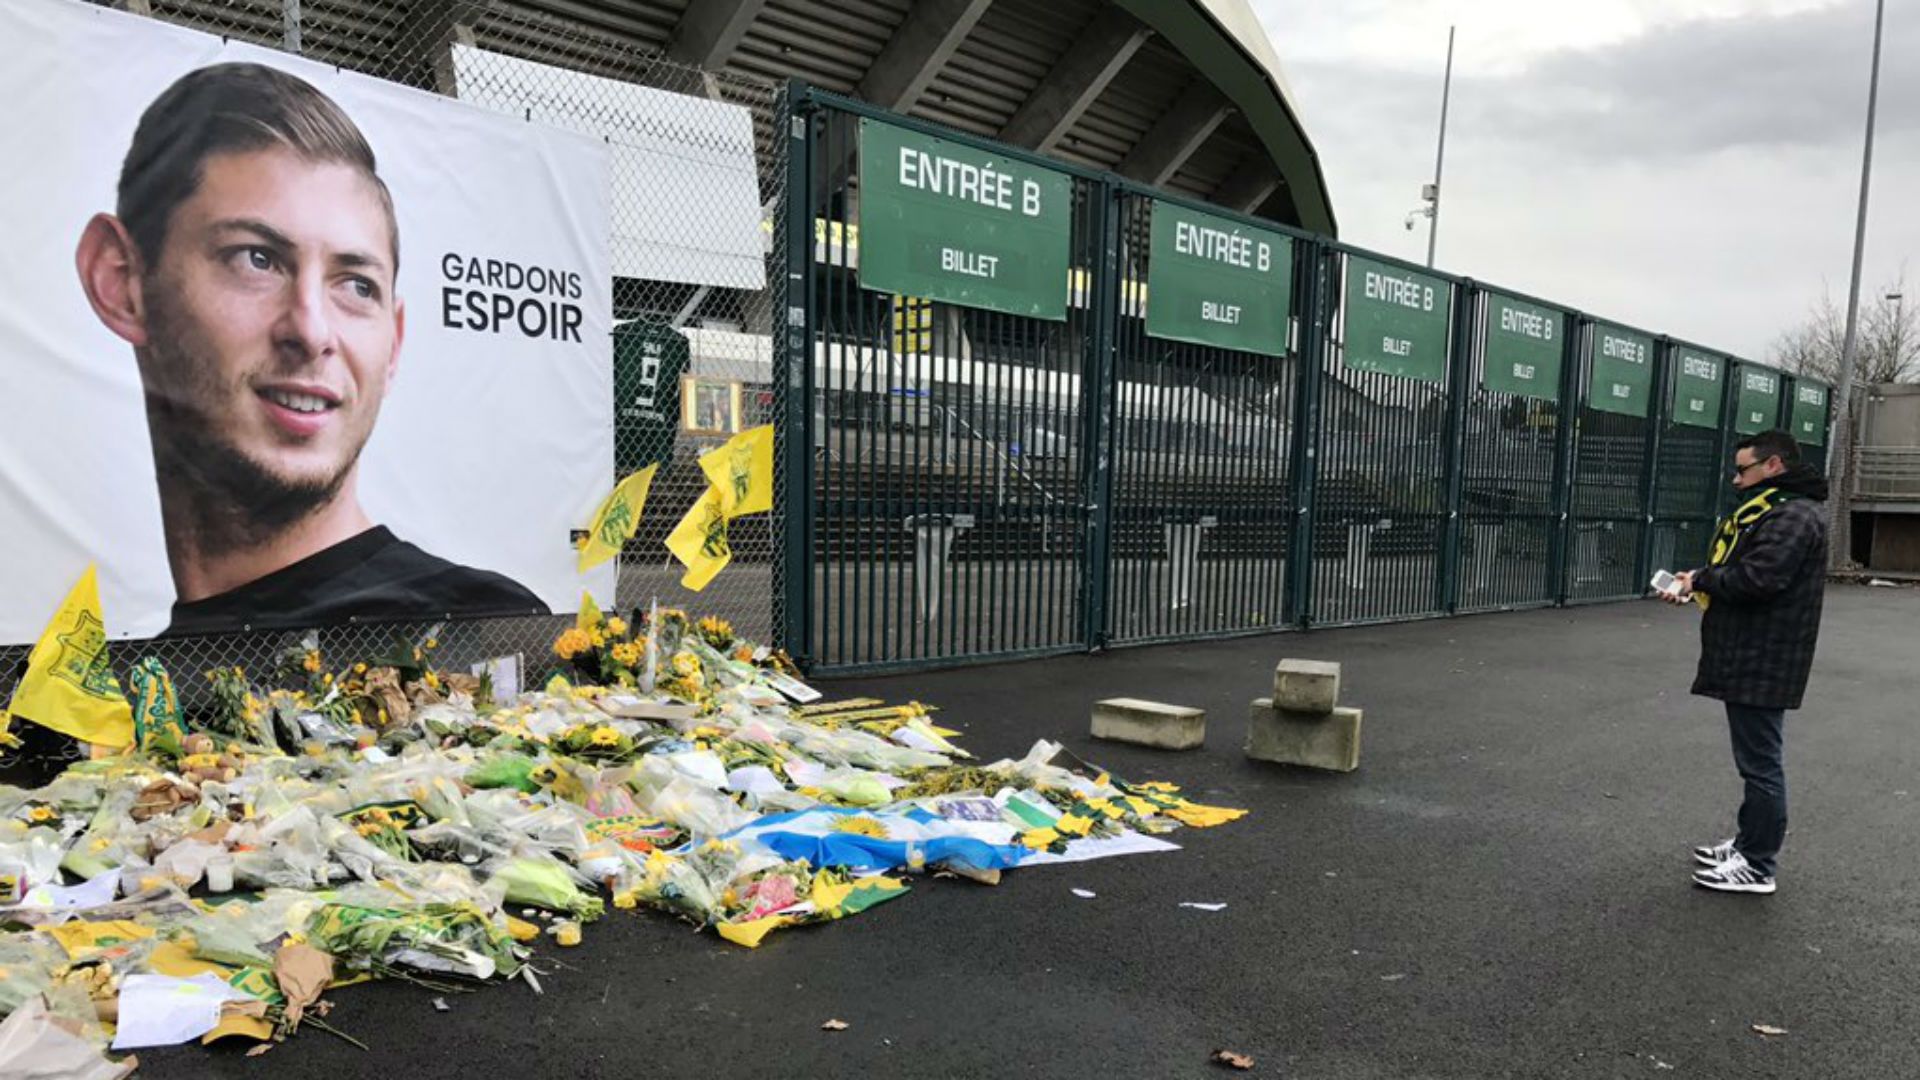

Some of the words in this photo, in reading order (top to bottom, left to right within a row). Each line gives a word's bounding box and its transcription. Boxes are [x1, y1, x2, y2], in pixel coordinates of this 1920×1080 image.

[899, 146, 1012, 210] ENTRÉE
[1023, 181, 1040, 217] B
[941, 248, 998, 279] BILLET
[1175, 221, 1251, 267] ENTRÉE
[1257, 242, 1271, 272] B
[442, 253, 582, 300] GARDONS
[1365, 272, 1420, 309] ENTRÉE
[1423, 287, 1433, 311] B
[442, 287, 582, 343] ESPOIR
[1202, 301, 1242, 325] BILLET
[1502, 307, 1542, 338] ENTRÉE
[1544, 319, 1552, 340] B
[1383, 337, 1413, 356] BILLET
